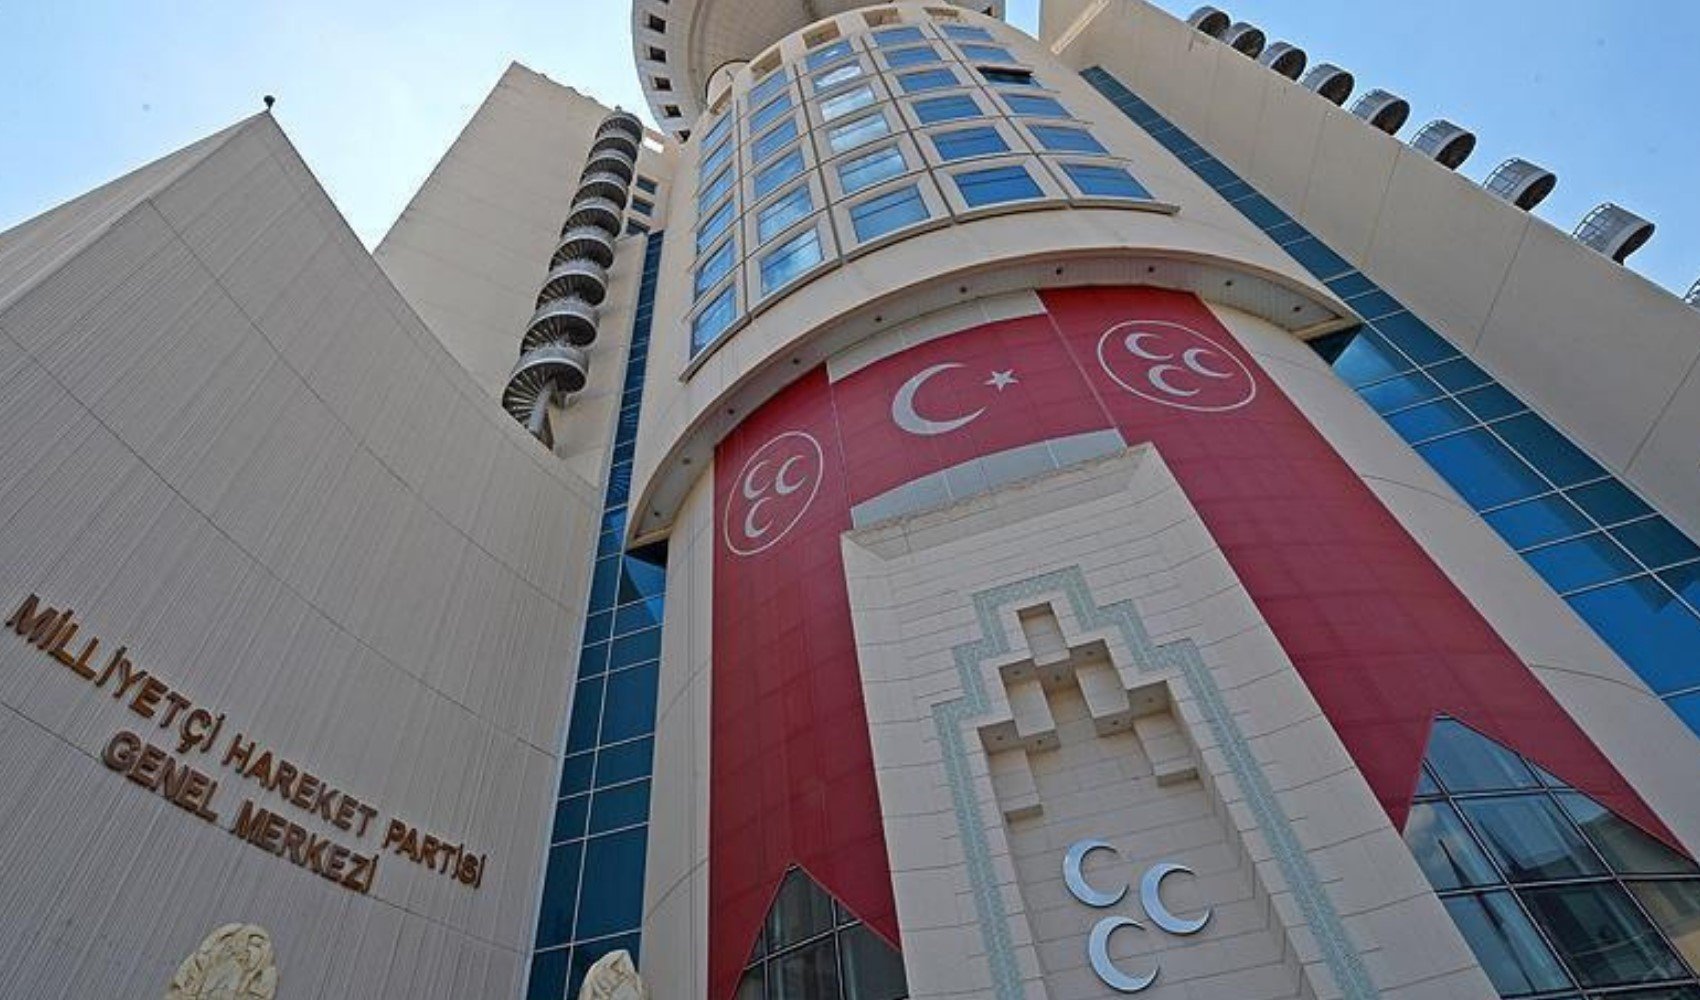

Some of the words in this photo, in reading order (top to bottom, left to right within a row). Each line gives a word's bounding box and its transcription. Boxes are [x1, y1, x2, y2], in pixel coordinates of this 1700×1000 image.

[5, 592, 226, 754] MİLLİYETÇİ
[221, 733, 378, 838] HAREKET
[382, 818, 487, 889] PARTİSİ
[101, 730, 219, 823] GENEL
[229, 799, 381, 894] MERKEZİ
